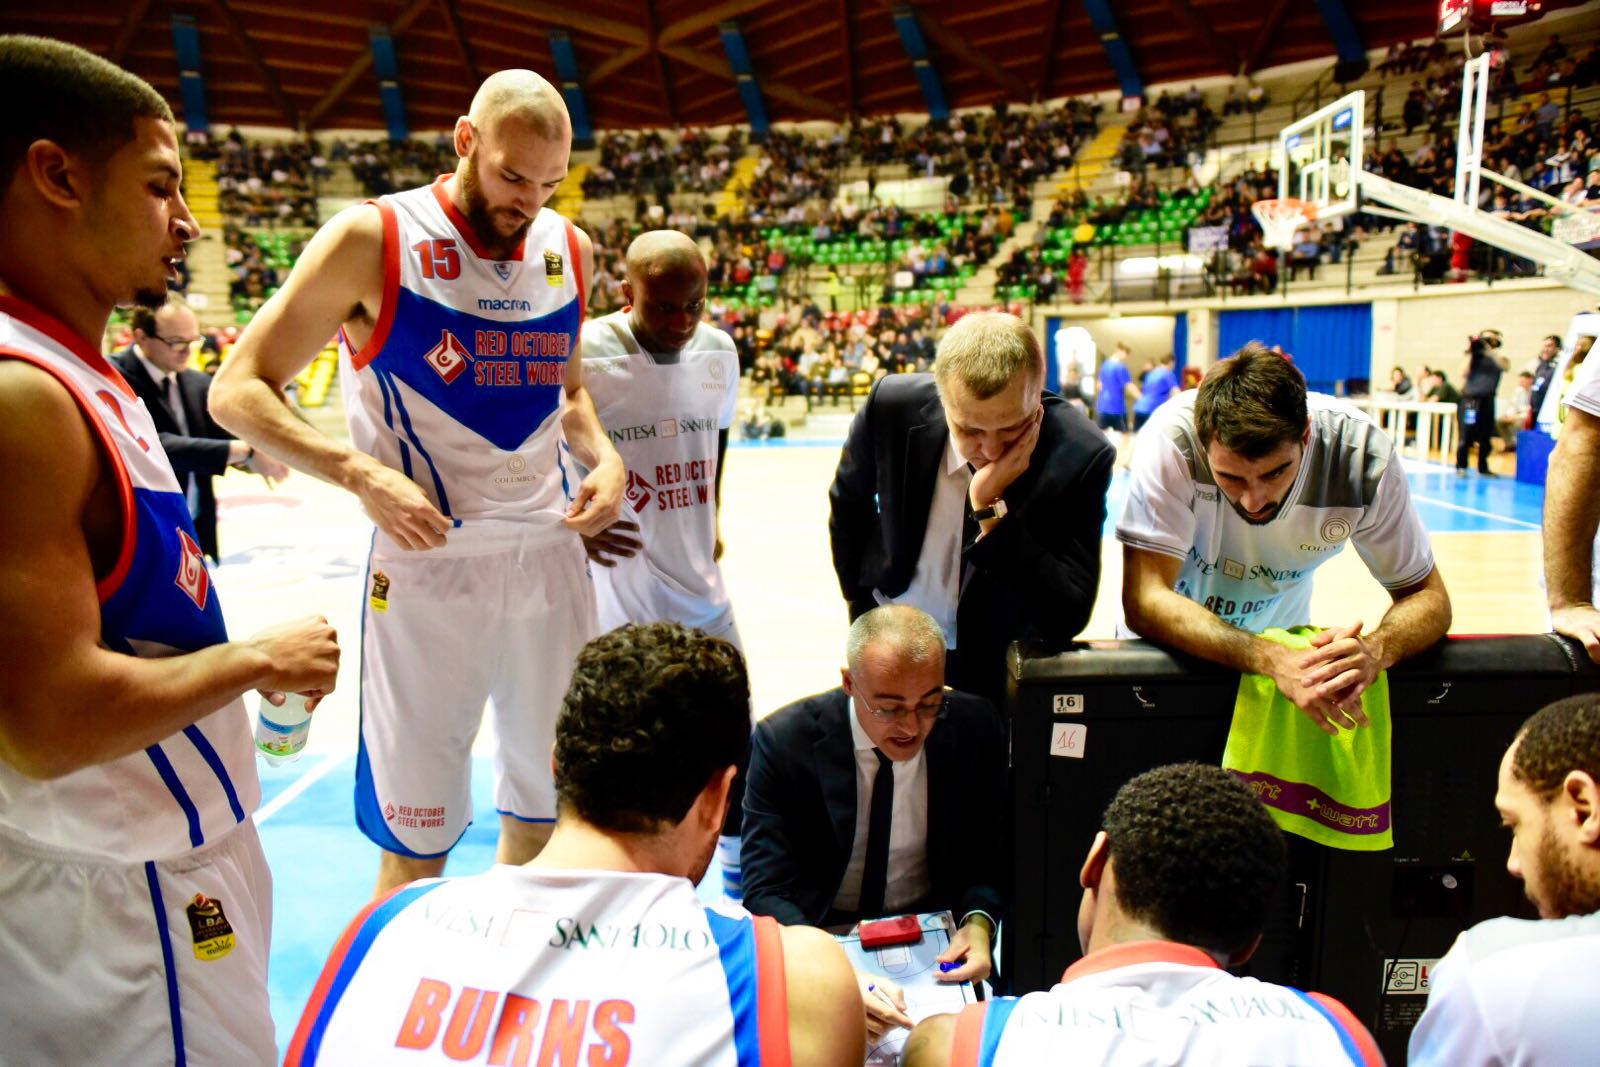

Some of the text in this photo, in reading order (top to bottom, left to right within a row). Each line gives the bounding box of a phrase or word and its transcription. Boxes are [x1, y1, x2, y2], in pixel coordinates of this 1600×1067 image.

[412, 239, 461, 281] 15
[478, 298, 531, 312] macron
[475, 330, 507, 356] RED
[474, 361, 521, 386] STEEL
[608, 424, 657, 443] INTESA
[655, 462, 682, 486] RED
[1204, 595, 1237, 616] RED
[1056, 696, 1076, 707] 16
[1056, 729, 1077, 750] 16
[397, 816, 446, 828] STEEL WORKS
[399, 805, 446, 818] RED OCTOBER
[394, 977, 636, 1067] BURNS
